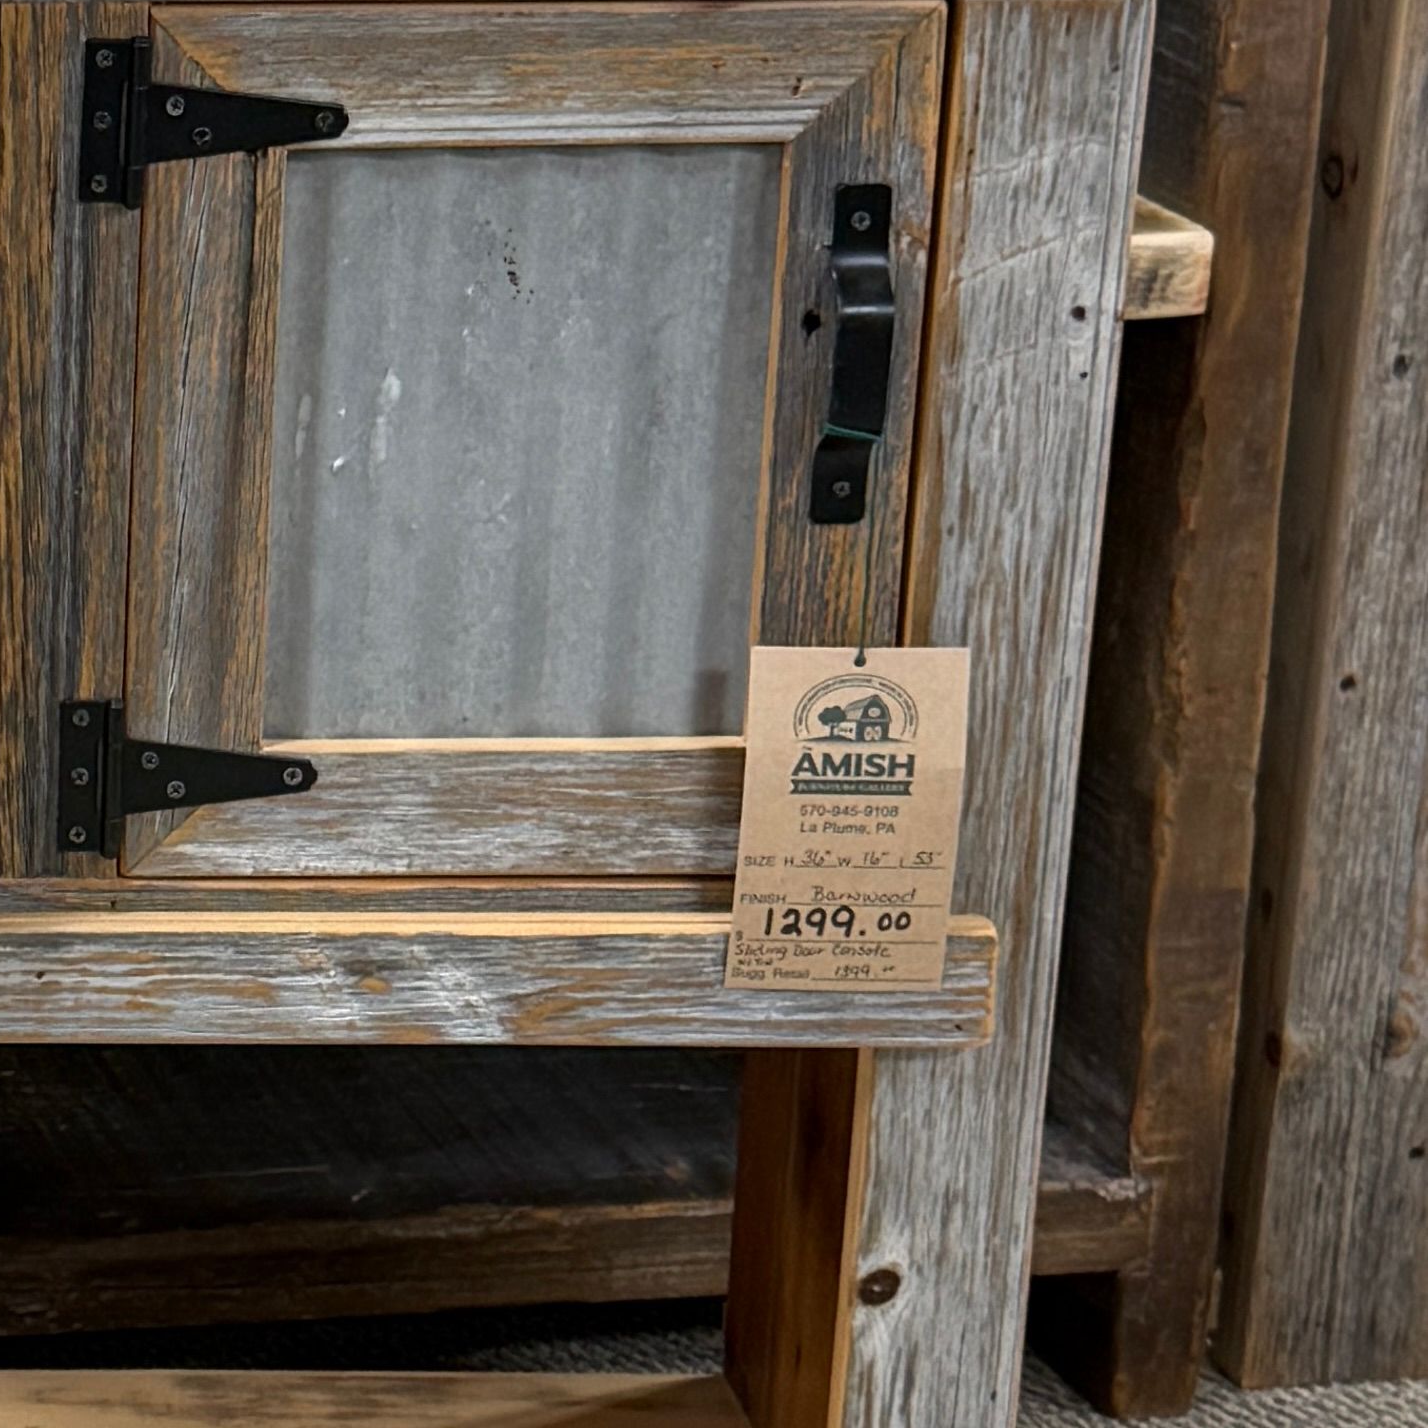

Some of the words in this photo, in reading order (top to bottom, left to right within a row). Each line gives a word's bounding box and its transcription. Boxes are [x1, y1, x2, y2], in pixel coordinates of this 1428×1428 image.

[791, 752, 915, 778] AMISH
[799, 821, 817, 834] La
[875, 822, 896, 834] PA
[743, 855, 777, 867] SIZE
[784, 856, 794, 867] H
[837, 856, 852, 867] W
[739, 893, 787, 905] FINISH
